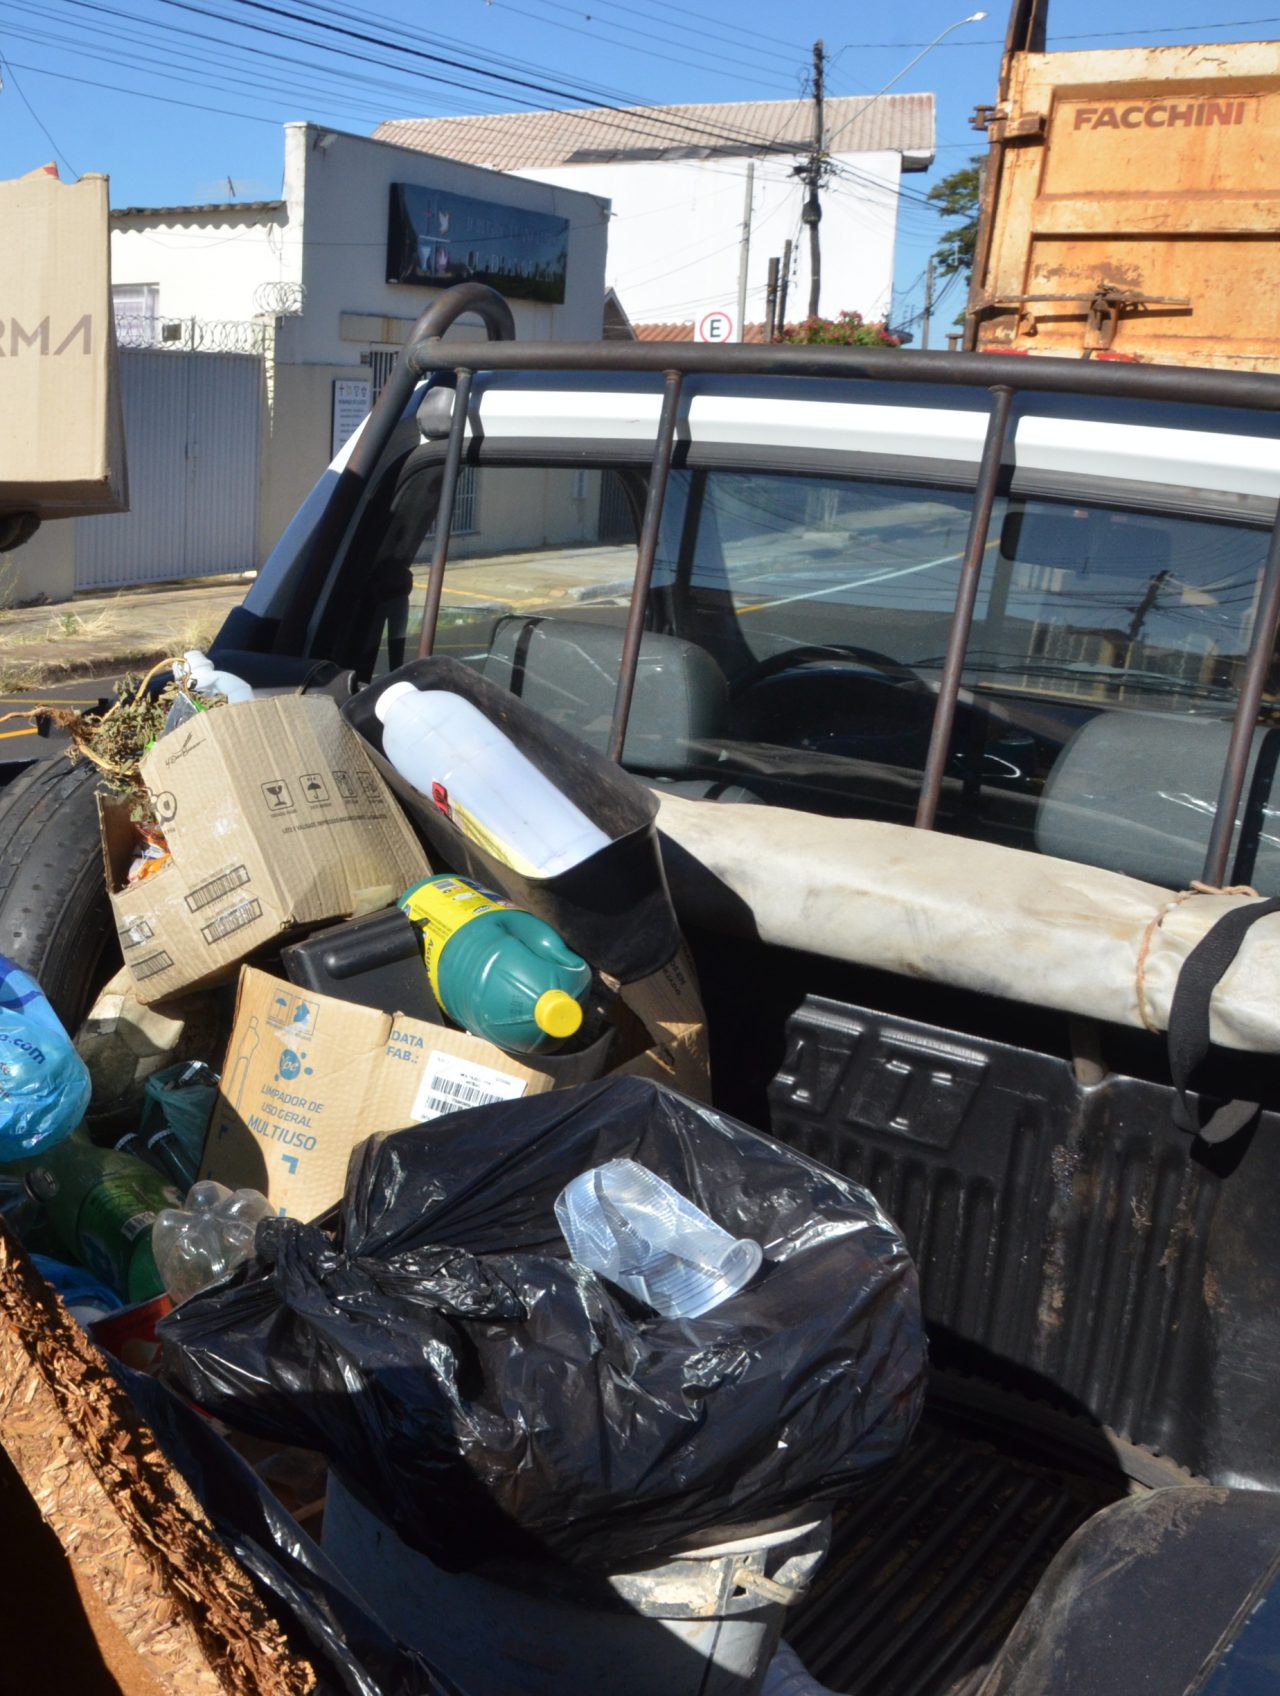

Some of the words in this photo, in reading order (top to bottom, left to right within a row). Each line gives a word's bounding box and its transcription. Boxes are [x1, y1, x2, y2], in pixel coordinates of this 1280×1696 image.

[1073, 102, 1246, 130] FACCHINI
[710, 318, 722, 338] E
[390, 1029, 425, 1049] DATA
[386, 1045, 420, 1064] FAB.:
[261, 1084, 307, 1109] LIMPADOR
[308, 1102, 324, 1114] DE
[261, 1102, 277, 1116] USO
[278, 1109, 312, 1128] GERAL
[247, 1114, 317, 1152] MULTIUSO
